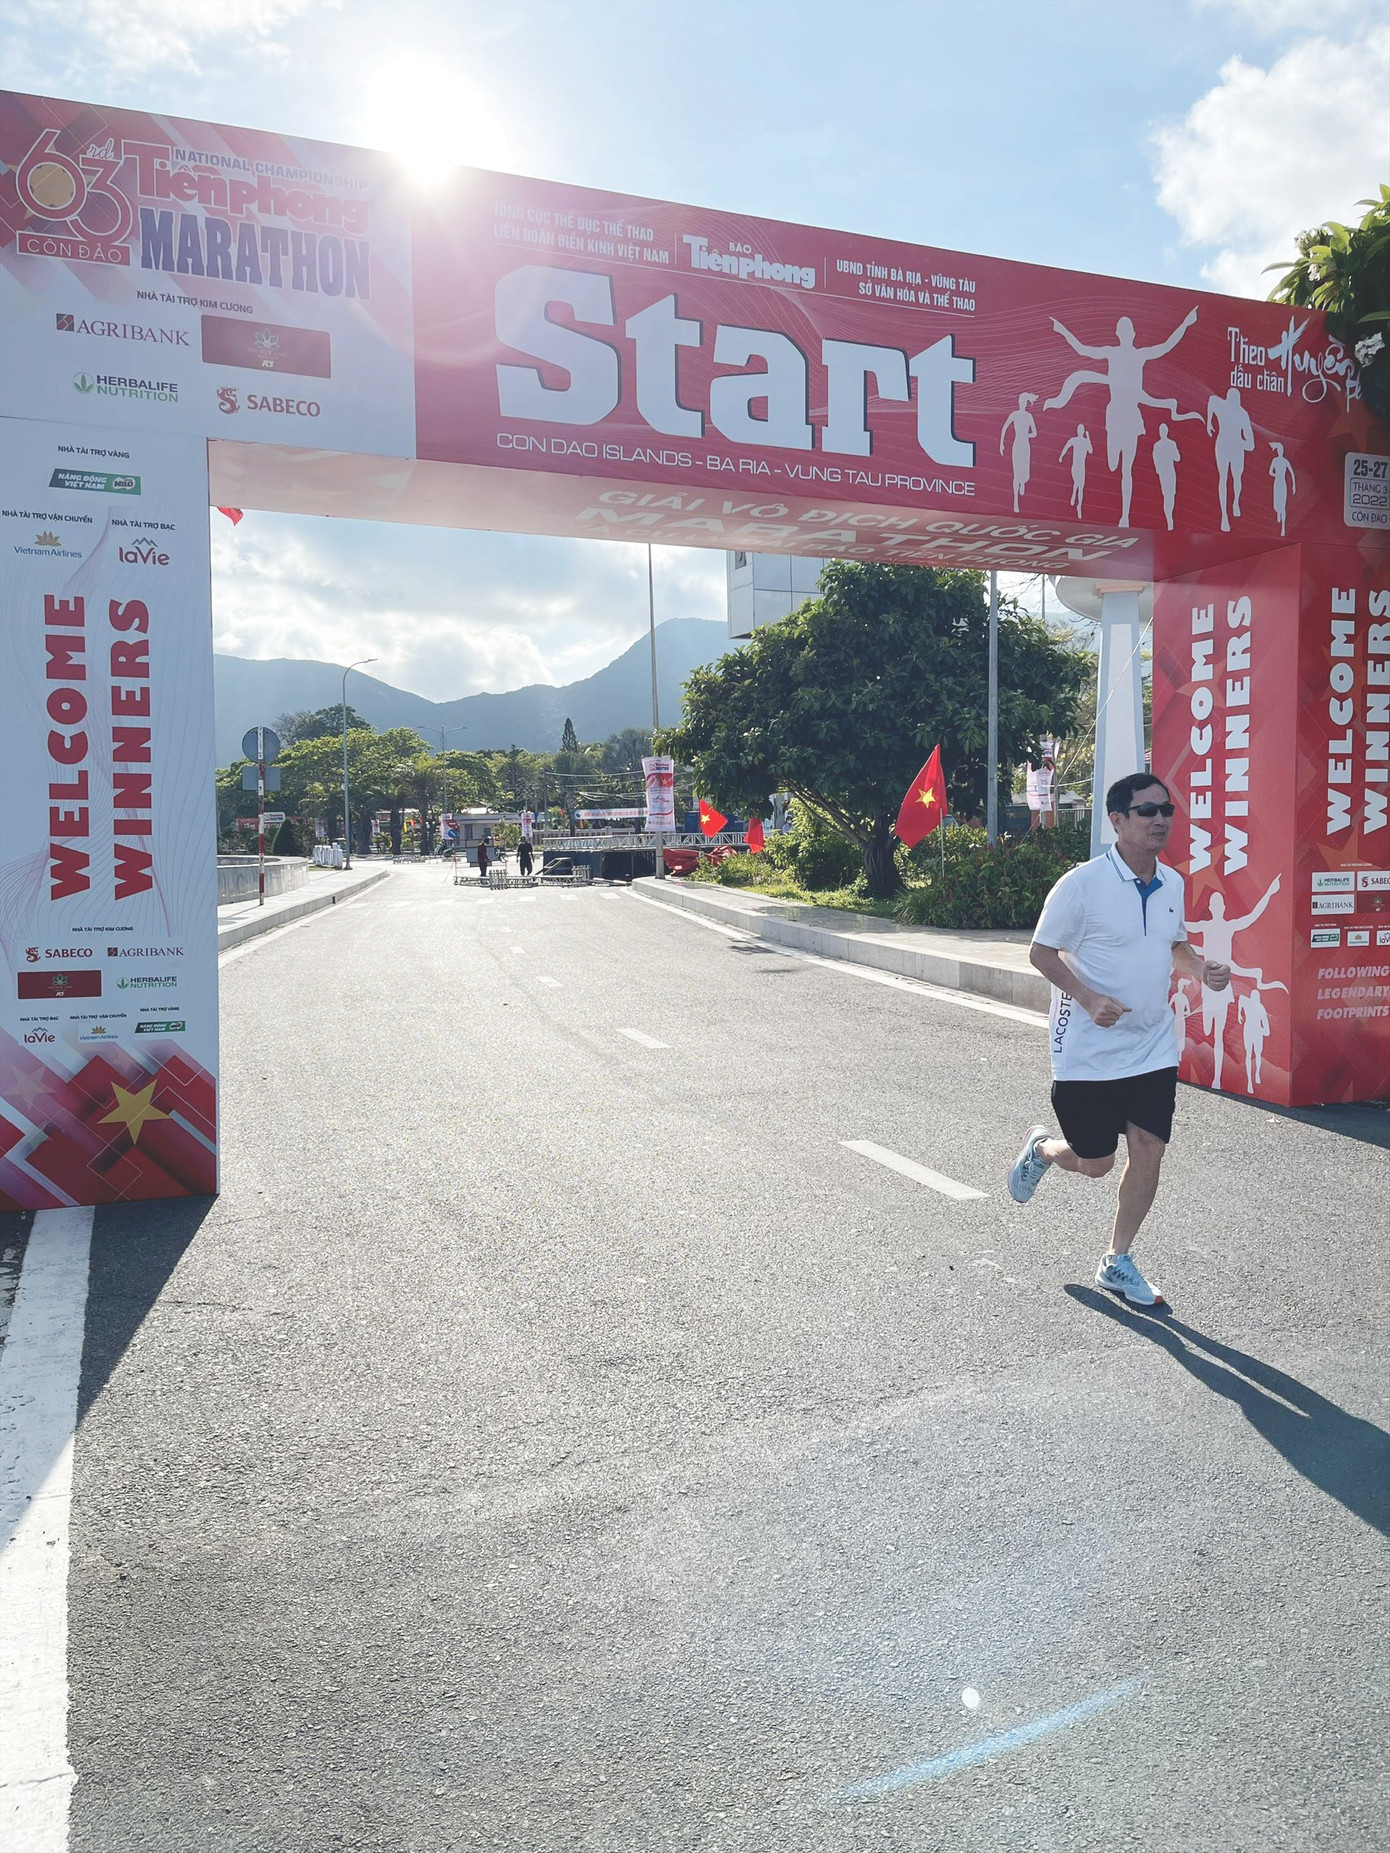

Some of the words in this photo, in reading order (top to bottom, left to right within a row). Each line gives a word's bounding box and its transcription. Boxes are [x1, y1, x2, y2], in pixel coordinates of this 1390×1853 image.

[175, 148, 251, 172] NATIONAL
[255, 162, 368, 190] CHAMPIONSHIP
[527, 207, 551, 226] CỤC
[553, 209, 575, 229] THỂ
[603, 219, 624, 237] THỂ
[626, 225, 654, 241] THAO
[27, 239, 71, 257] CÔN
[79, 243, 122, 263] ĐẢO
[139, 206, 371, 301] MARATHON
[493, 223, 520, 240] LIÊN
[588, 239, 615, 256] KINH
[617, 243, 640, 262] VIỆT
[643, 248, 670, 264] NAM
[836, 259, 863, 276] UBND
[866, 261, 888, 280] TỈNH
[890, 266, 903, 282] BÀ
[906, 271, 922, 287] RỊA
[931, 274, 956, 290] VŨNG
[958, 277, 976, 293] TÀU
[136, 290, 158, 301] NHÀ
[160, 293, 176, 303] TÀI
[177, 296, 198, 308] TRỢ
[200, 299, 218, 309] KIM
[219, 302, 254, 314] CƯƠNG
[859, 280, 873, 295] SỞ
[875, 283, 894, 299] VĂN
[897, 287, 916, 302] HÓA
[918, 290, 931, 305] VÀ
[933, 291, 950, 307] THỂ
[952, 296, 976, 311] THAO
[76, 319, 191, 347] AGRIBANK
[1227, 326, 1266, 366] Theo
[494, 264, 977, 468] Start
[1230, 364, 1252, 389] dấu
[1257, 368, 1285, 393] chân
[97, 375, 178, 393] HERBALIFE
[97, 385, 179, 403] NUTRITION
[247, 395, 321, 418] SABECO
[90, 449, 106, 457] TRỢ
[107, 450, 130, 458] VÀNG
[497, 433, 547, 453] CON
[551, 438, 598, 458] DAO
[603, 444, 692, 467] ISLANDS
[706, 455, 735, 472] BA
[739, 459, 770, 476] RIA
[785, 463, 841, 482] VUNG
[845, 469, 882, 486] TAU
[885, 474, 976, 496] PROVINCE
[1353, 458, 1388, 478] 25-27
[64, 480, 84, 488] VIỆT
[85, 482, 105, 490] NAM
[114, 479, 134, 487] MILO
[1382, 485, 1388, 494] 3
[1352, 493, 1388, 507] 2022
[2, 510, 18, 518] NHÀ
[19, 510, 30, 518] TÀI
[48, 513, 63, 521] VẬN
[64, 515, 93, 523] CHUYỂN
[143, 522, 159, 530] TRỢ
[160, 523, 176, 531] BẠC
[597, 490, 705, 511] GIẢI
[798, 509, 919, 529] ĐỊCH
[926, 521, 1061, 541] QUỐC
[1065, 533, 1140, 549] GIA
[958, 555, 1071, 570] PHONG
[1327, 587, 1356, 836] WELCOME
[1364, 589, 1390, 835] WINNERS
[44, 594, 90, 901] WELCOME
[1189, 604, 1214, 875] WELCOME
[1223, 595, 1251, 877] WINNERS
[109, 598, 153, 901] WINNERS
[45, 948, 93, 958] SABECO
[119, 947, 184, 957] AGRIBANK
[1317, 965, 1390, 980] FOLLOWING
[1317, 985, 1390, 1000] LEGENDARY
[1054, 992, 1073, 1053] LACOSTE
[1317, 1005, 1390, 1020] FOOTPRINTS
